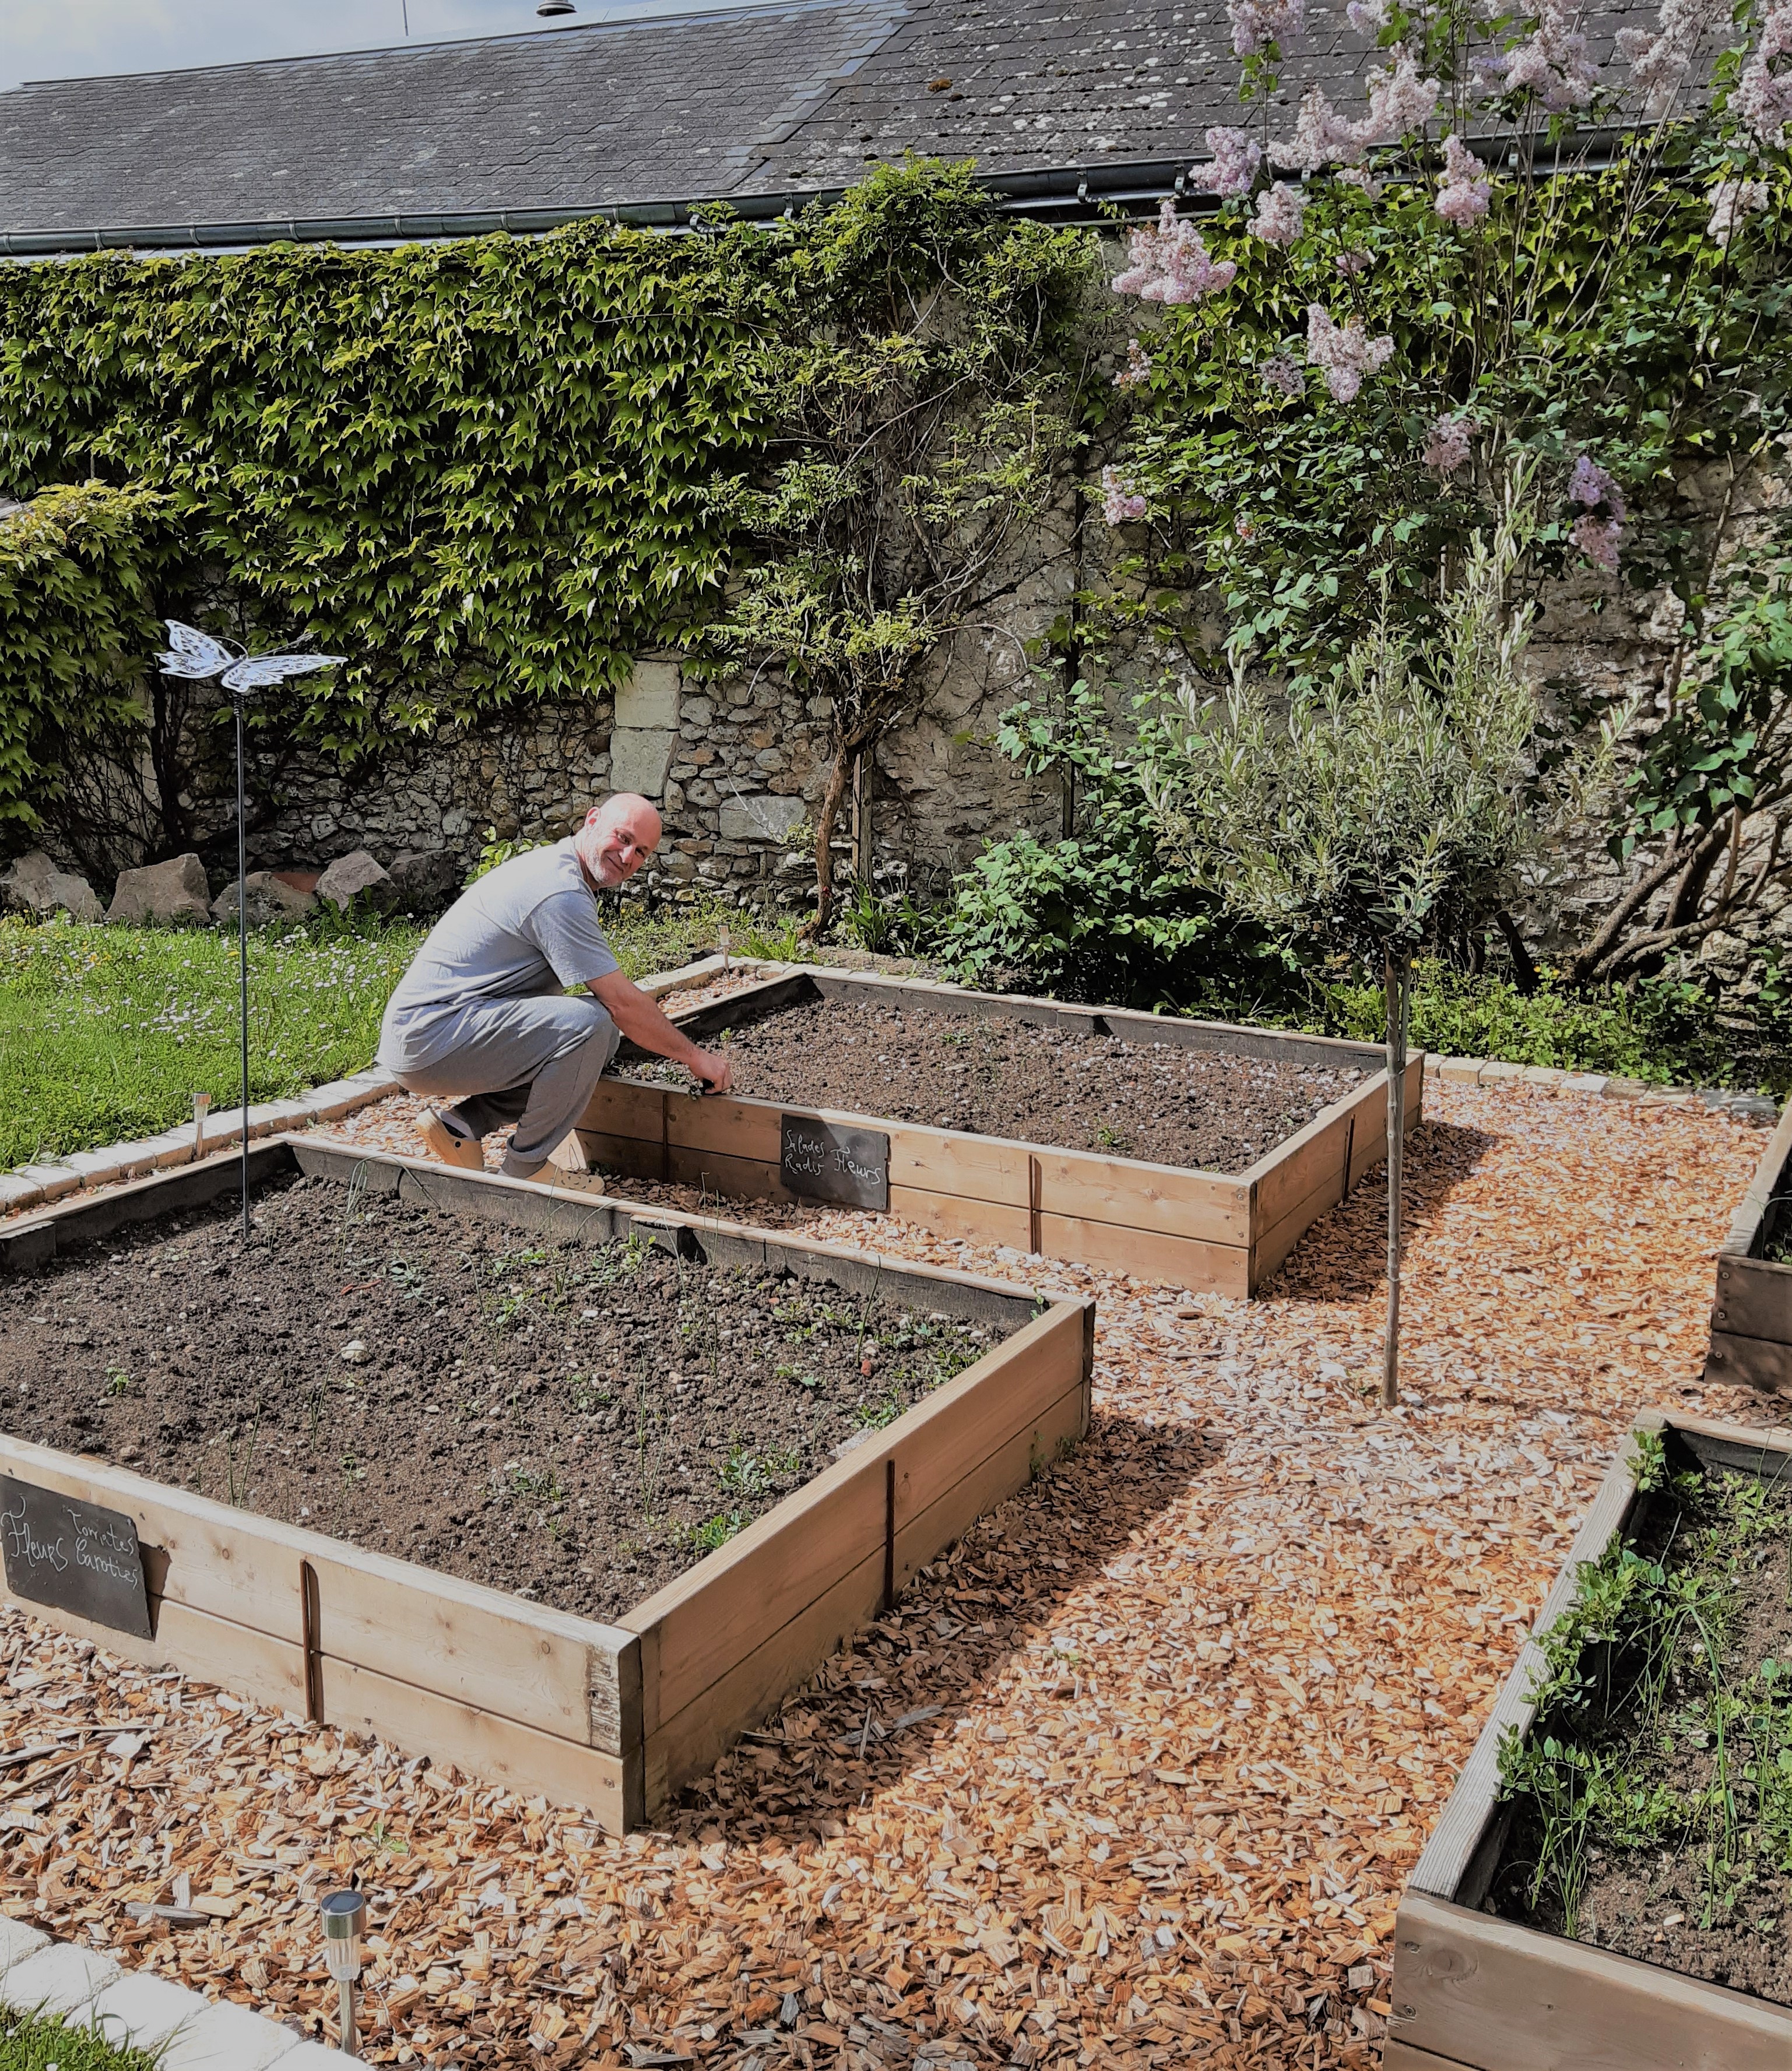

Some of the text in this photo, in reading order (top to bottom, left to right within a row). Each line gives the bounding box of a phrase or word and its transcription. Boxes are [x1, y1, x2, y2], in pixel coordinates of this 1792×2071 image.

[785, 1130, 824, 1158] Salades
[785, 1153, 824, 1176] Radis
[830, 1146, 881, 1184] Fleurs
